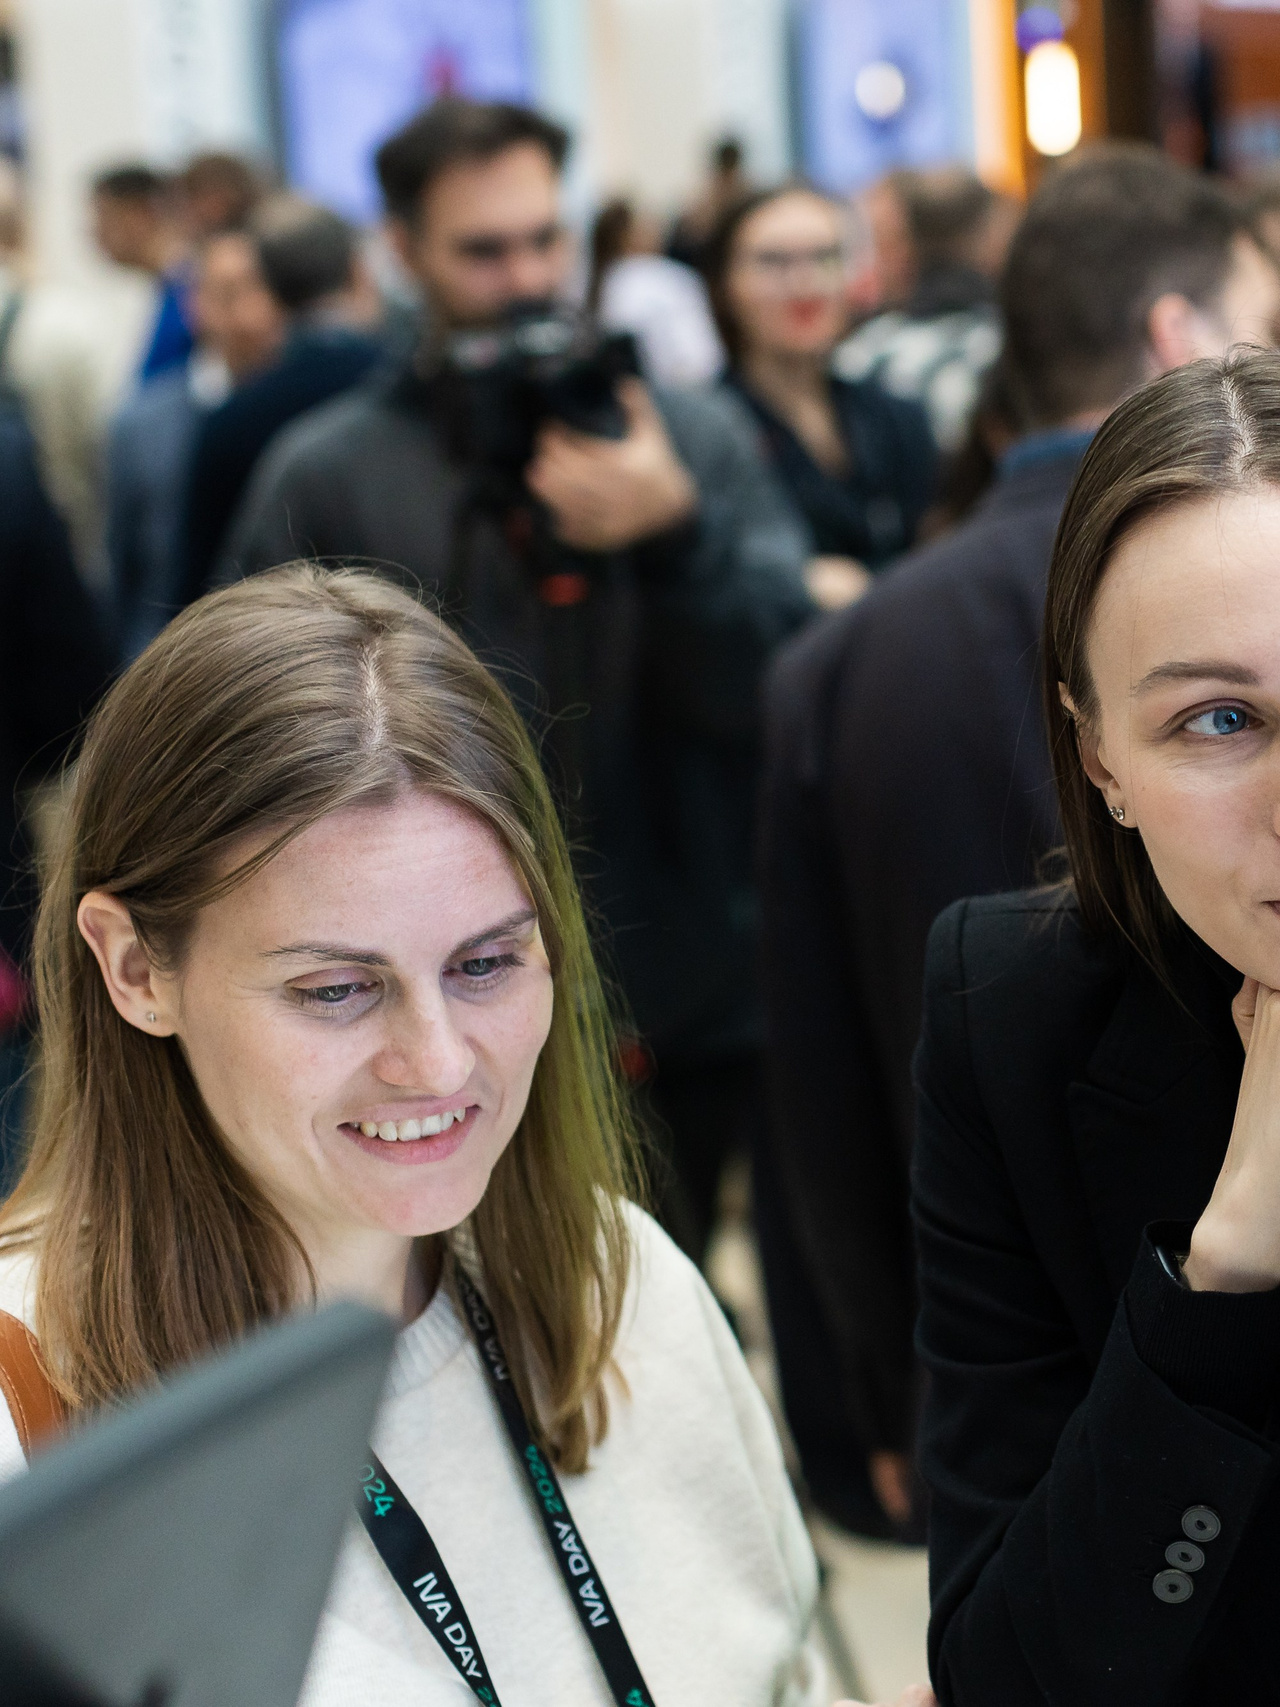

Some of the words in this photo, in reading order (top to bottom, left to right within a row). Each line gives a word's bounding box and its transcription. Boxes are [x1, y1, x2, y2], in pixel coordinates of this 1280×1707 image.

[359, 1464, 394, 1517] 024
[525, 1444, 563, 1514] 2024
[553, 1520, 590, 1576] DAY
[413, 1571, 452, 1623] IVA
[444, 1622, 482, 1678] DAY
[579, 1577, 610, 1628] IVA
